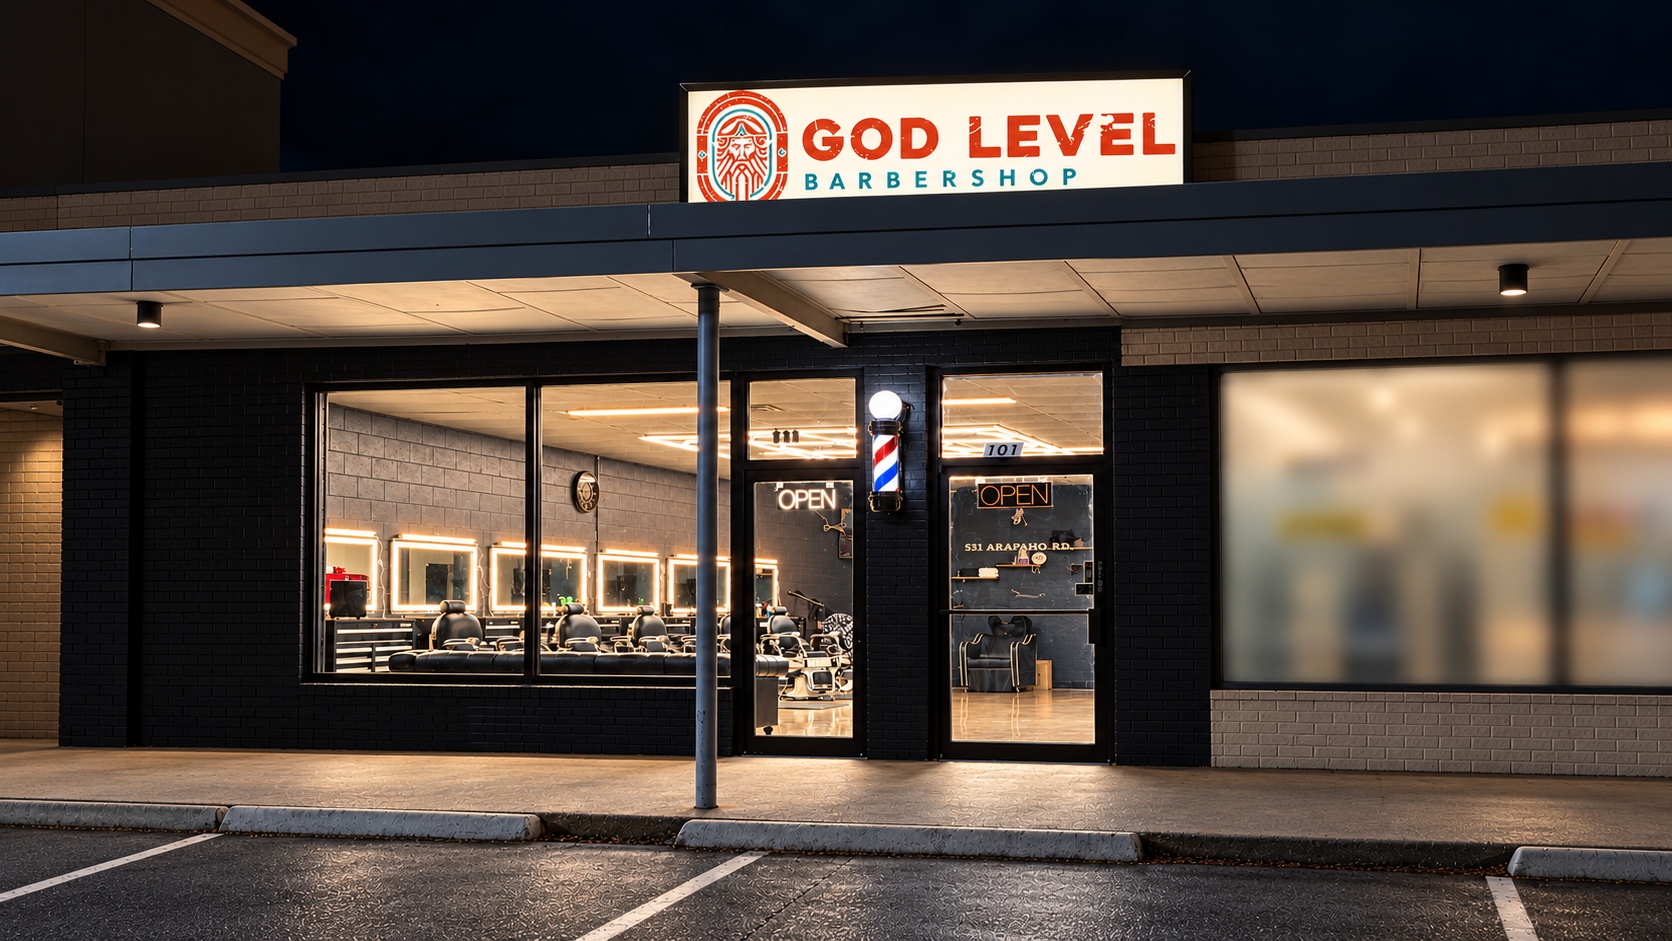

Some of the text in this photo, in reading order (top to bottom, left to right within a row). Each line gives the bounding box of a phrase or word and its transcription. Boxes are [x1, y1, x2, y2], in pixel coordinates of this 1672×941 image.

[802, 112, 1176, 162] GOD LEVEL
[804, 167, 1077, 191] BARBERSHOP
[988, 444, 1018, 456] 101
[777, 488, 837, 510] OPEN
[980, 483, 1049, 506] OPEN
[985, 542, 1048, 552] ARAPAHO
